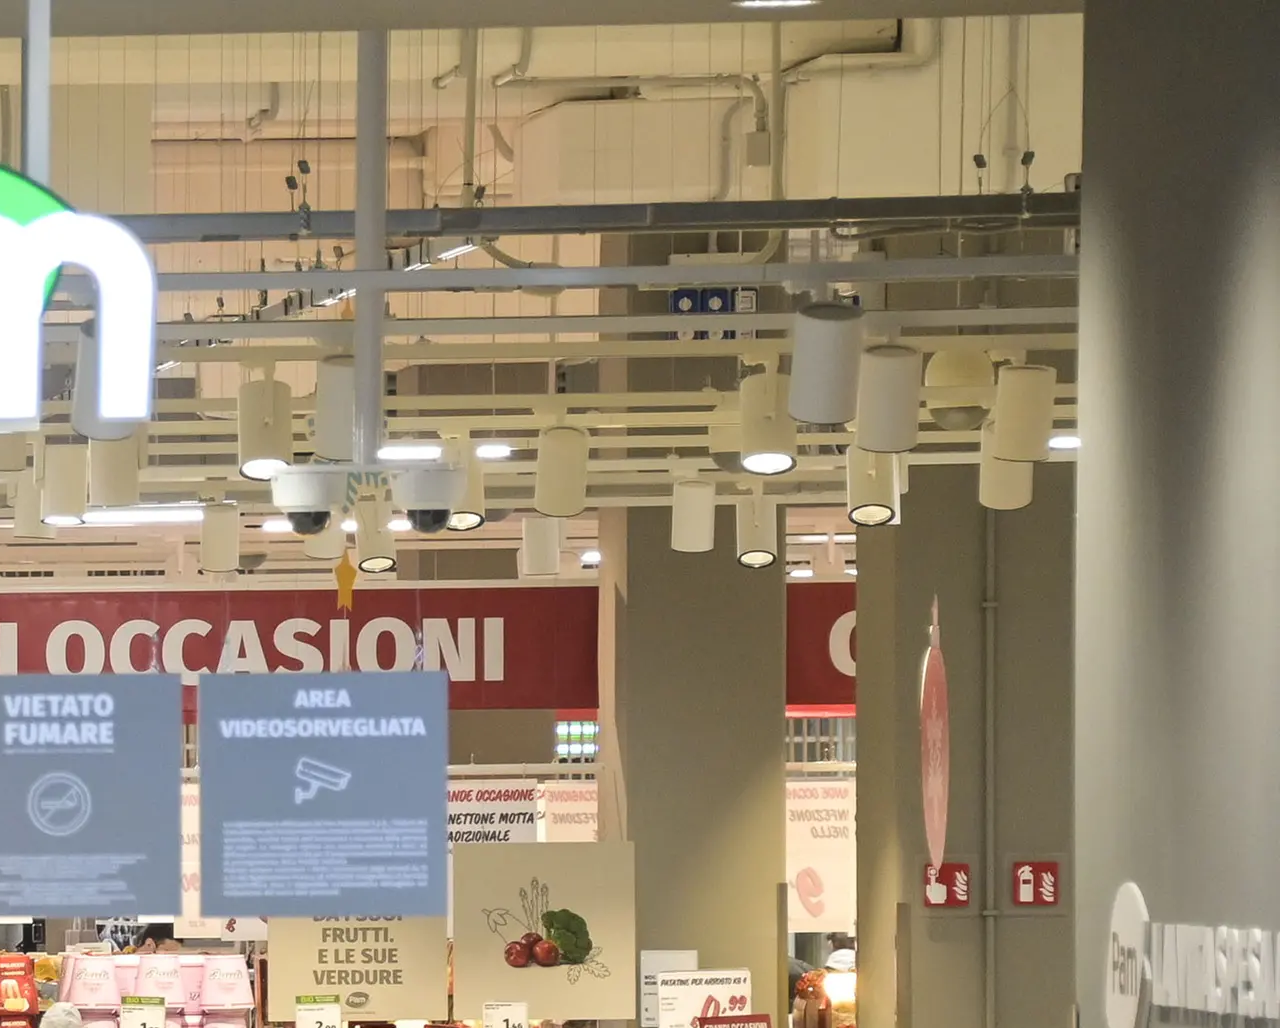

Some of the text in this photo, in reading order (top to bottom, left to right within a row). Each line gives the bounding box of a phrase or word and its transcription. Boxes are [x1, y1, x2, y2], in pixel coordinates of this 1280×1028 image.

[45, 617, 504, 683] OCCASIONI
[4, 692, 114, 719] VIETATO
[294, 688, 351, 708] AREA
[4, 721, 114, 746] FUMARE
[219, 716, 426, 739] VIDEOSORVEGLIATA
[448, 789, 535, 802] ANDE OCCASIONE
[448, 813, 534, 825] NETTONE MOTTA
[322, 927, 394, 942] FRUTTI.
[318, 949, 398, 964] E LE SUE
[1112, 931, 1138, 996] Pam
[313, 970, 403, 985] VERDURE
